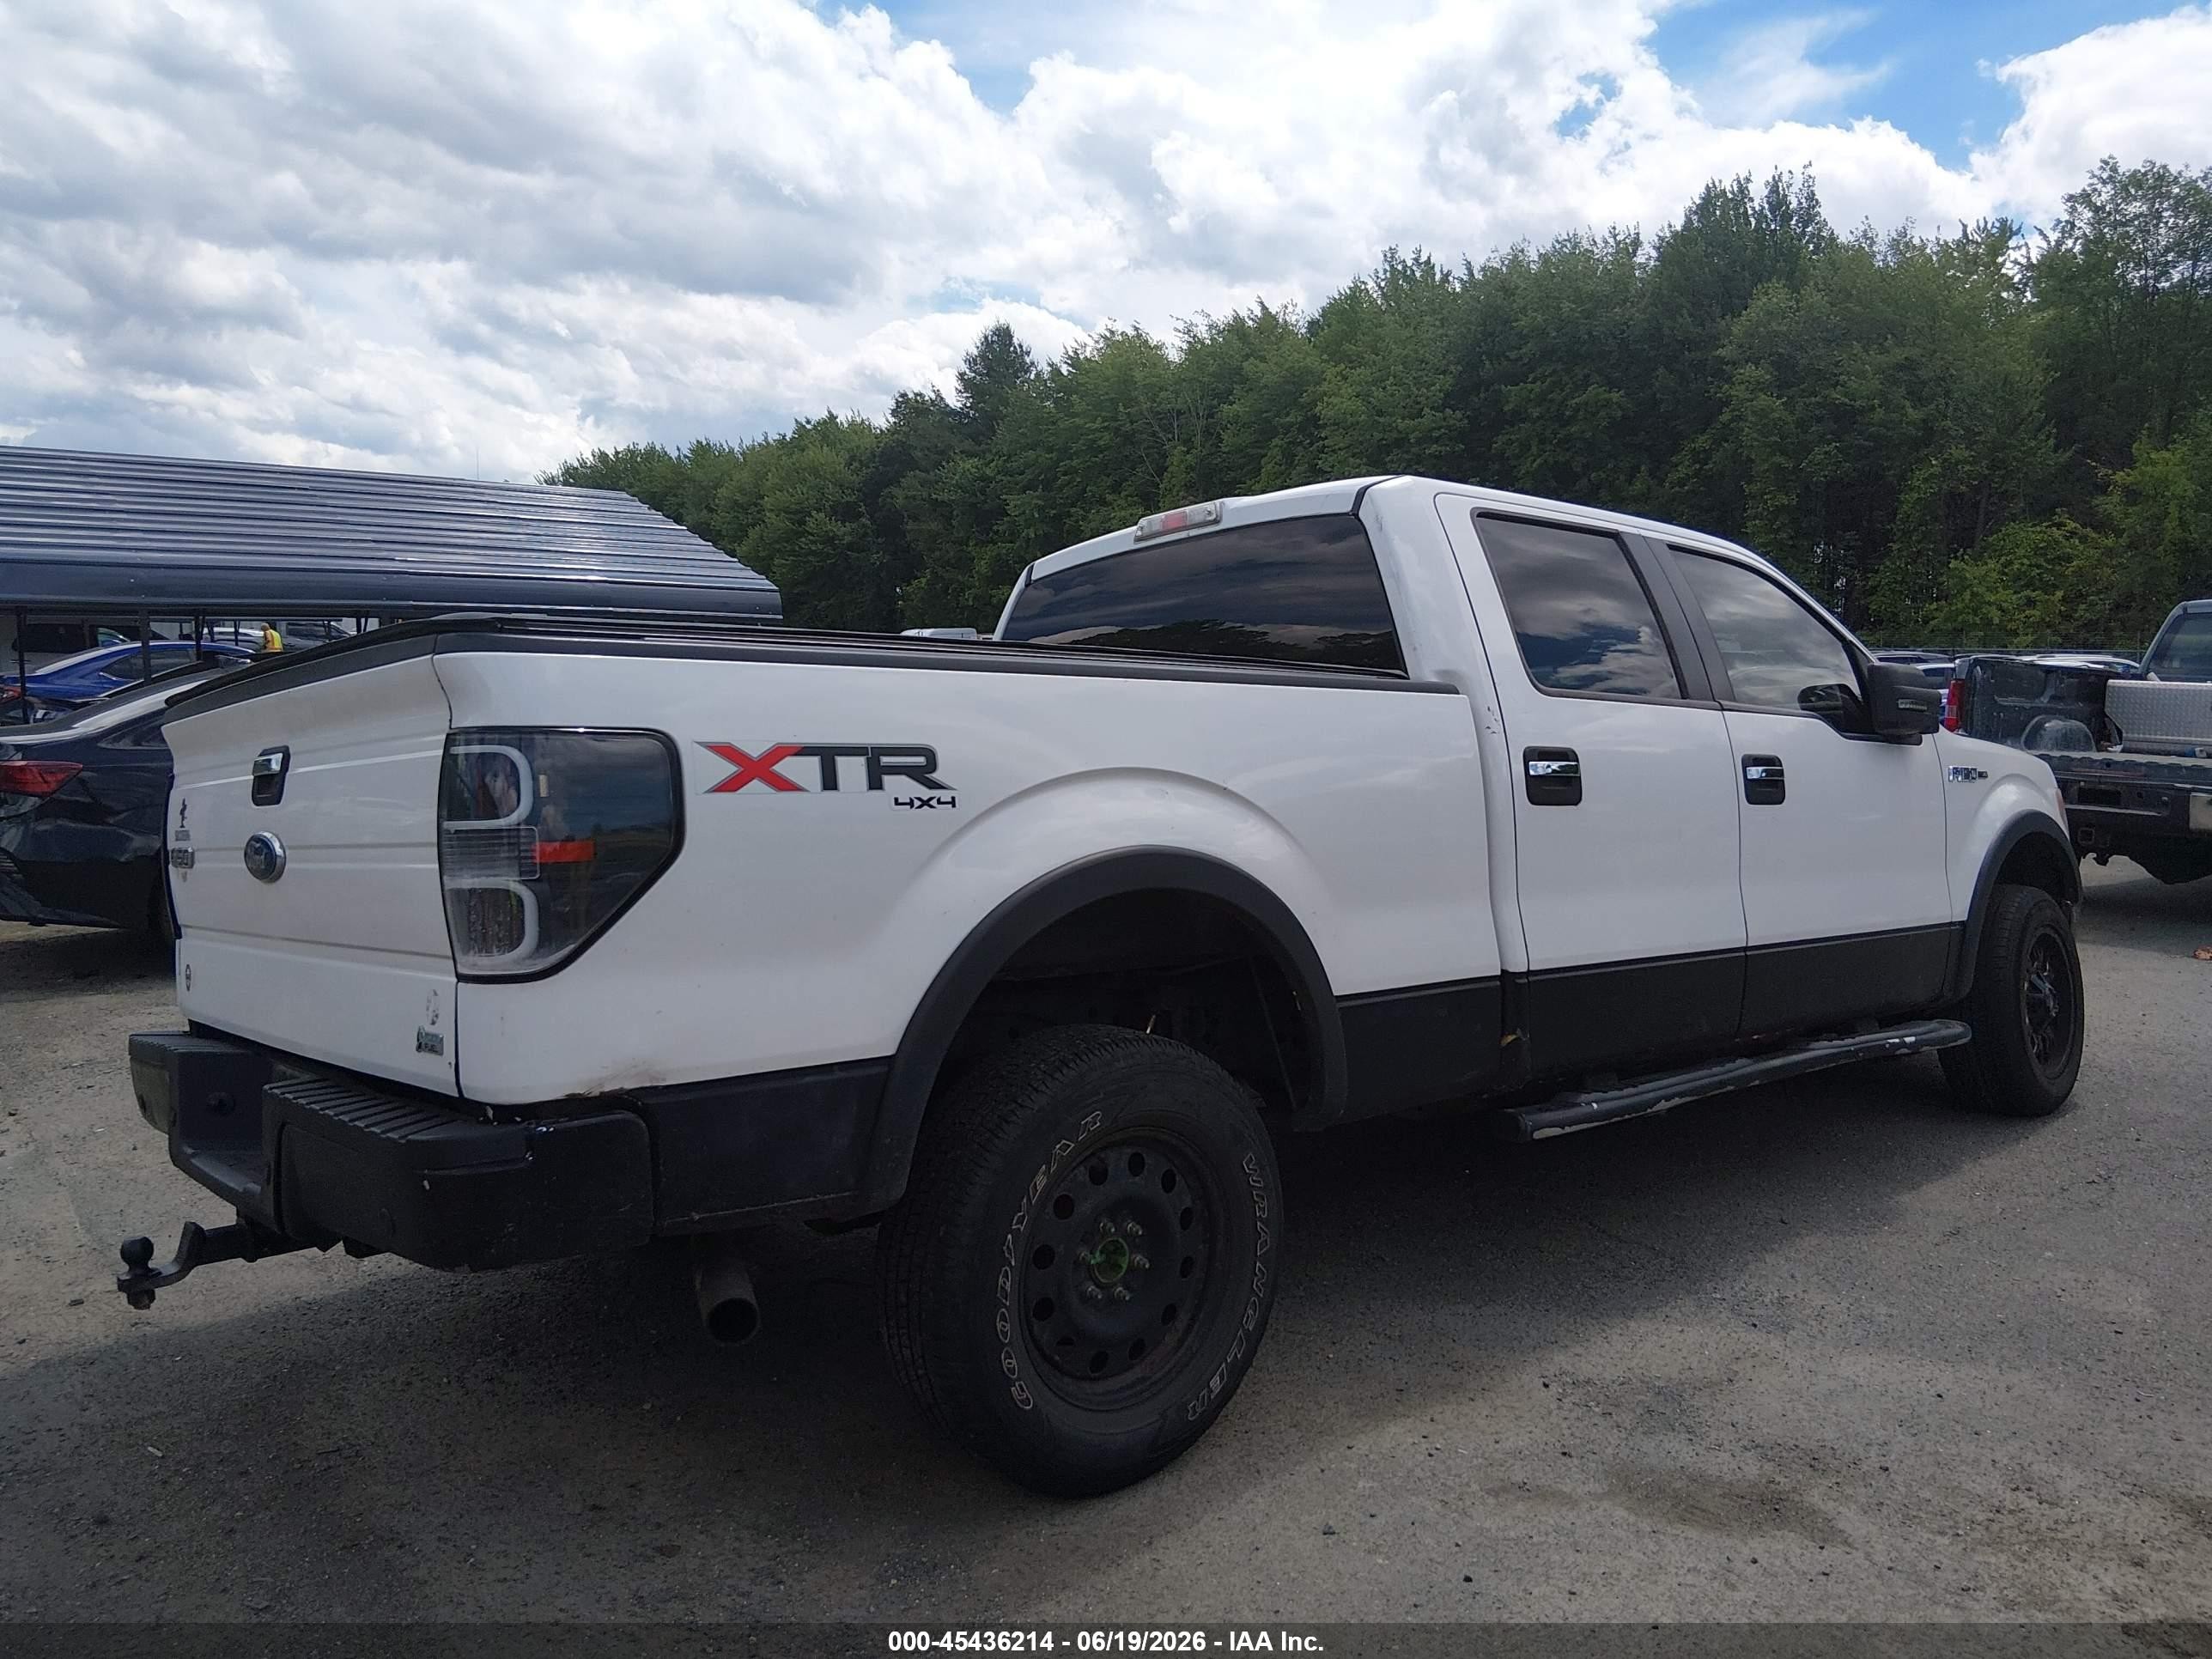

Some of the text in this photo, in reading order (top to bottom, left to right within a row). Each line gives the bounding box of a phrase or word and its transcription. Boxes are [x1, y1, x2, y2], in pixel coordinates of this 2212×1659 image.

[695, 741, 957, 793] XTR
[995, 1110, 1104, 1411] GOODYEAR
[1187, 1152, 1271, 1422] WRANGLER
